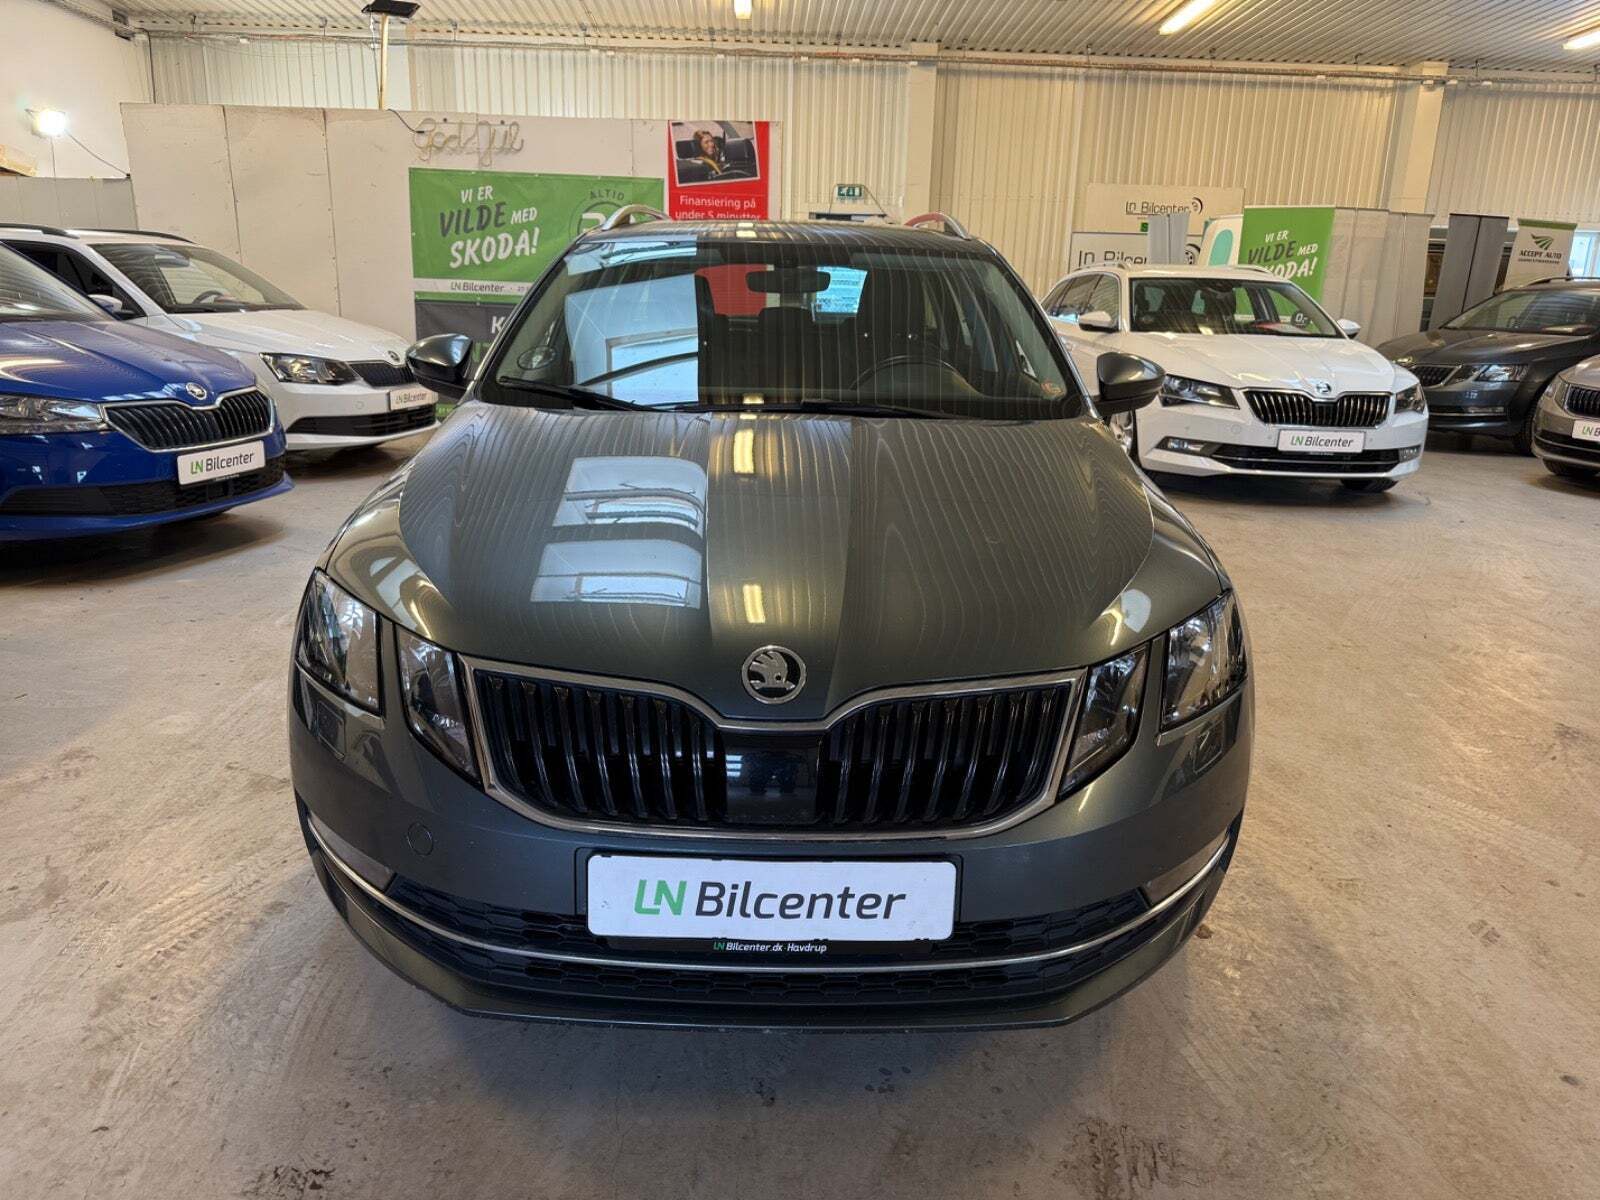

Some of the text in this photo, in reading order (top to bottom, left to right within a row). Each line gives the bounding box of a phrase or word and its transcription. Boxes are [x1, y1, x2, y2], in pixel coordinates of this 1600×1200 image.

[460, 185, 494, 203] VI ER
[589, 188, 625, 200] ALTID
[679, 194, 756, 210] Finansiering på
[440, 201, 537, 237] VILDE MED
[674, 210, 705, 220] under
[1264, 230, 1289, 243] VI ER
[449, 227, 539, 268] SKODA!
[1248, 241, 1318, 264] VILDE MED
[1519, 250, 1562, 259] ACCEPT AUTO
[1265, 256, 1318, 280] ODA!
[462, 282, 505, 293] Bilcenter
[1291, 435, 1354, 448] LN Bilcenter
[190, 452, 255, 475] LN Bilcenter
[633, 879, 906, 920] LN Bilcenter
[787, 942, 827, 955] Havdrup
